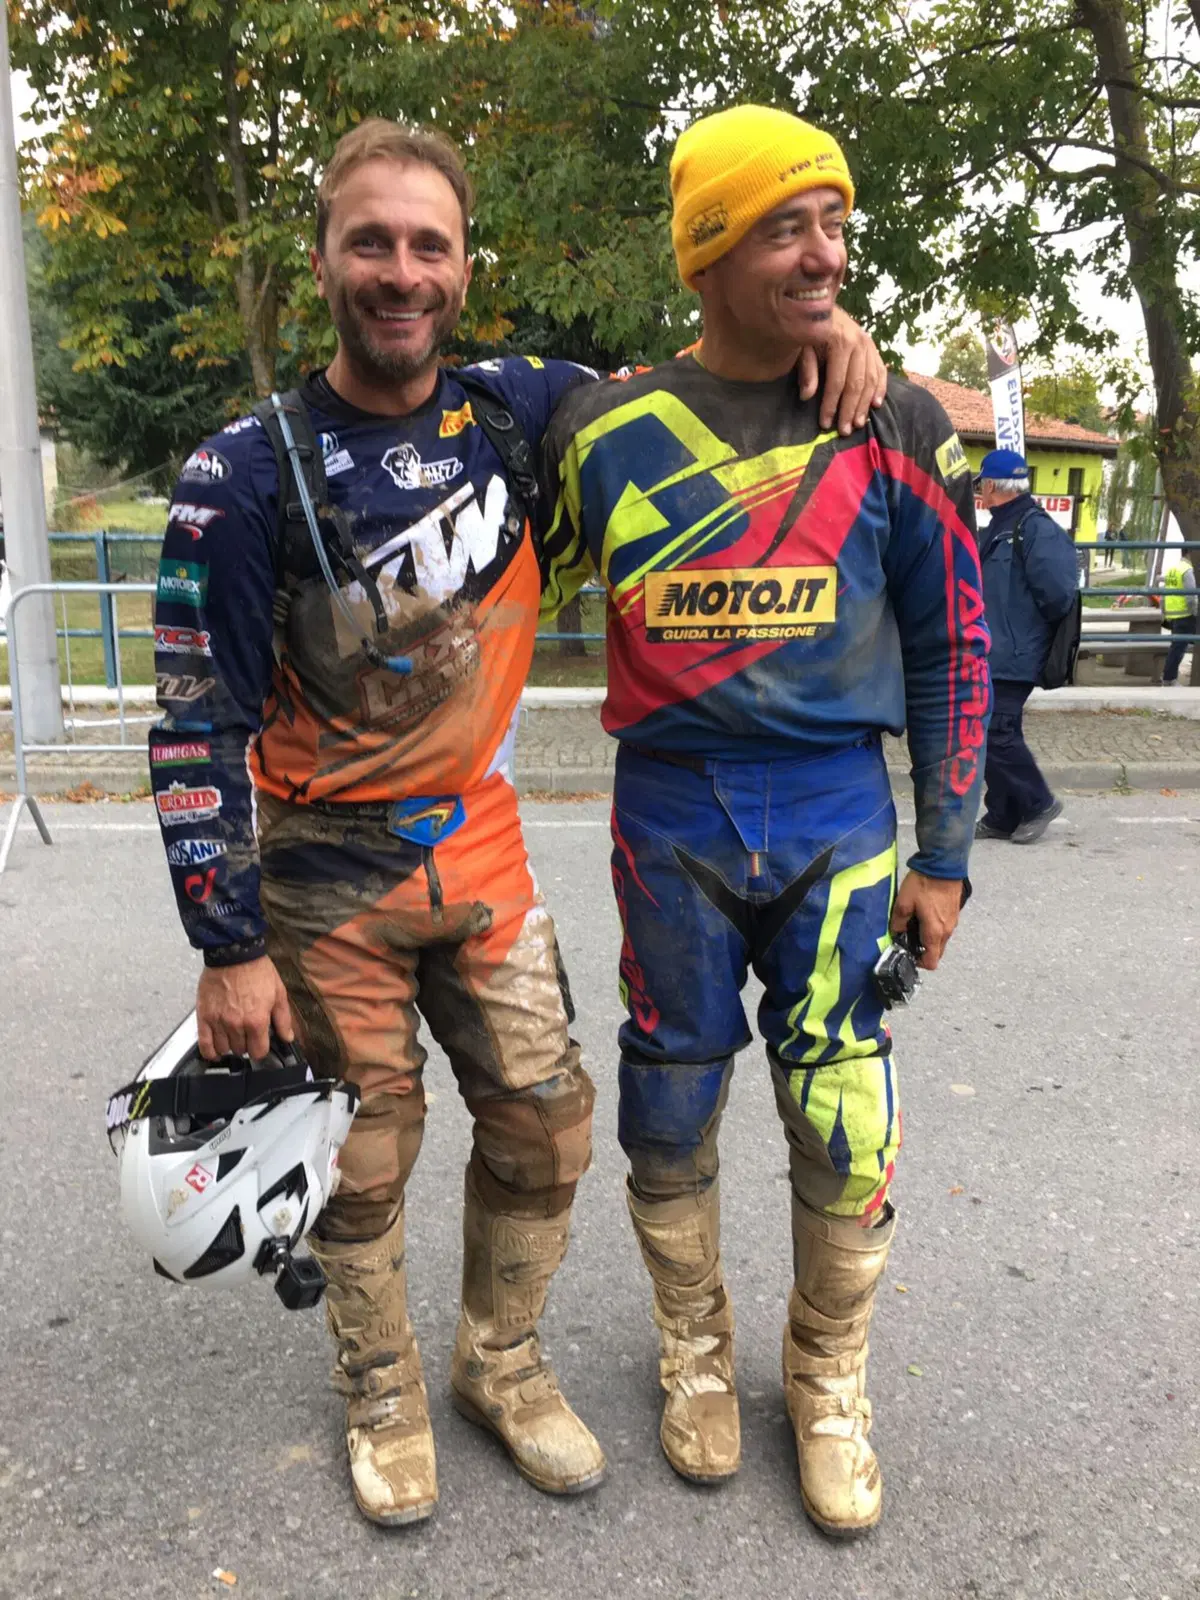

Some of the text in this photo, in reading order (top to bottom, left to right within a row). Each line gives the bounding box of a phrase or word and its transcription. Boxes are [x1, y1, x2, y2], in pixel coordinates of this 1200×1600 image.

[657, 578, 828, 617] MOTO.IT
[663, 626, 817, 641] GUIDA LA PASSIONE
